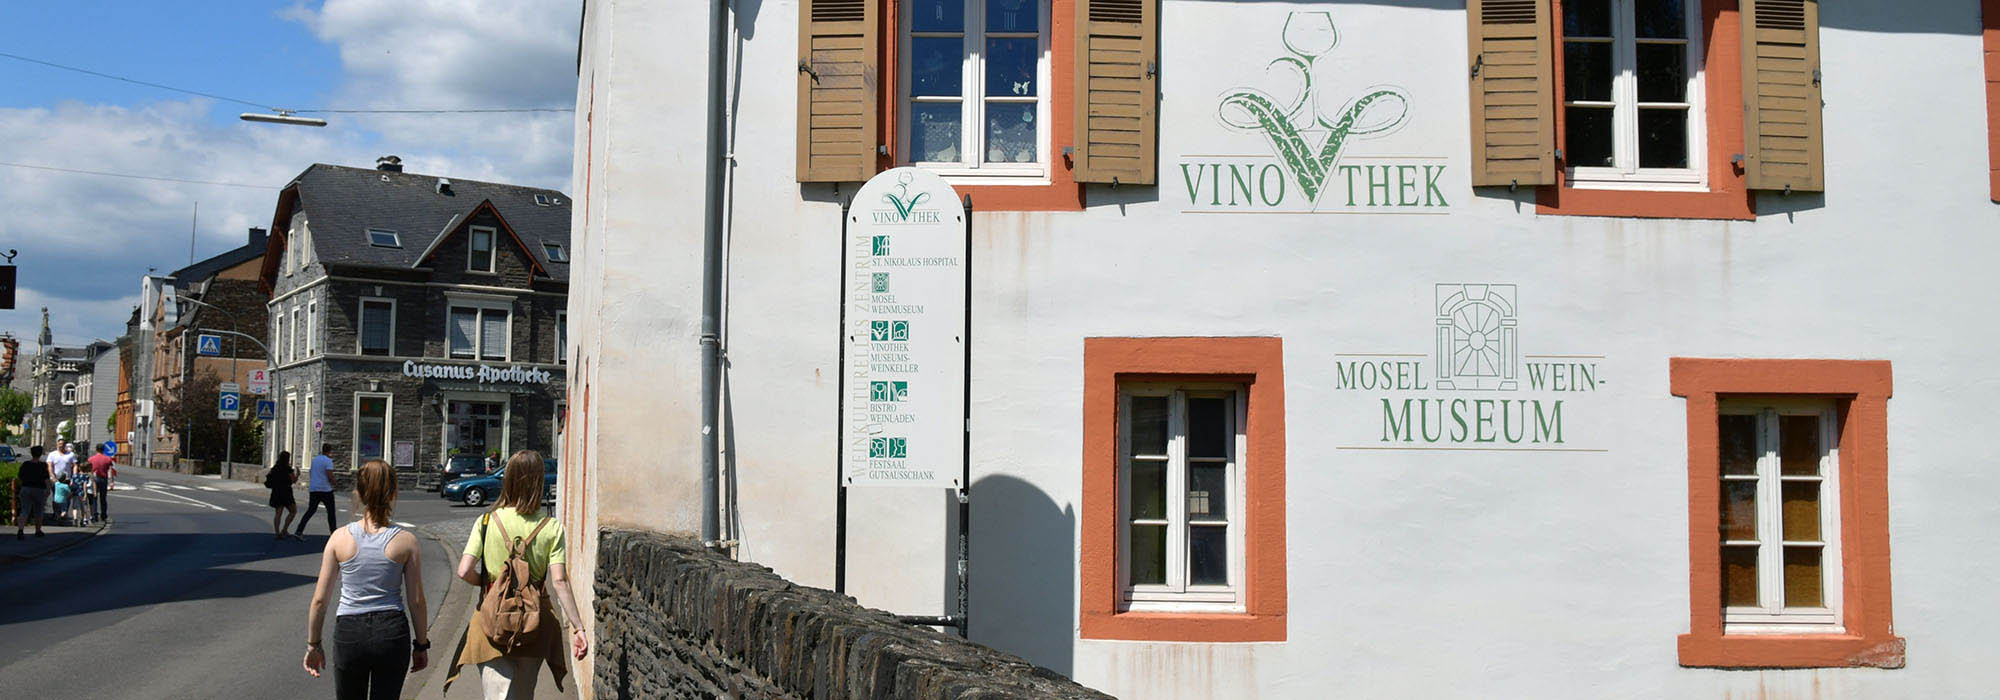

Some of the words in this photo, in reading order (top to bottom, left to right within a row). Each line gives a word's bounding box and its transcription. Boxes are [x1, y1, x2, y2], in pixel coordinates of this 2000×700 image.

[1180, 163, 1284, 207] VINO
[1338, 164, 1449, 207] THEK
[872, 211, 899, 223] VINO
[911, 211, 940, 223] THEK
[872, 257, 882, 267] ST.
[884, 257, 921, 267] NIKOLAUS
[923, 257, 958, 267] HOSPITAL
[855, 235, 871, 313] ZENTRUM
[872, 294, 897, 304] MOSEL
[872, 305, 924, 315] WEINMUSEUM
[871, 343, 909, 352] VINOTHEK
[871, 353, 911, 363] MUSEUMS-
[403, 359, 475, 381] Cusanus
[477, 363, 551, 385] Apotheke
[870, 364, 919, 374] WEINKELLER
[1335, 361, 1429, 391] MOSEL
[1526, 363, 1607, 392] WEIN-
[225, 398, 234, 409] P
[870, 403, 897, 413] BISTRO
[870, 414, 915, 424] WEINLADEN
[1380, 398, 1565, 444] MUSEUM
[869, 460, 907, 470] FESTSAAL
[869, 471, 935, 481] GUTSAUSSCHANK
